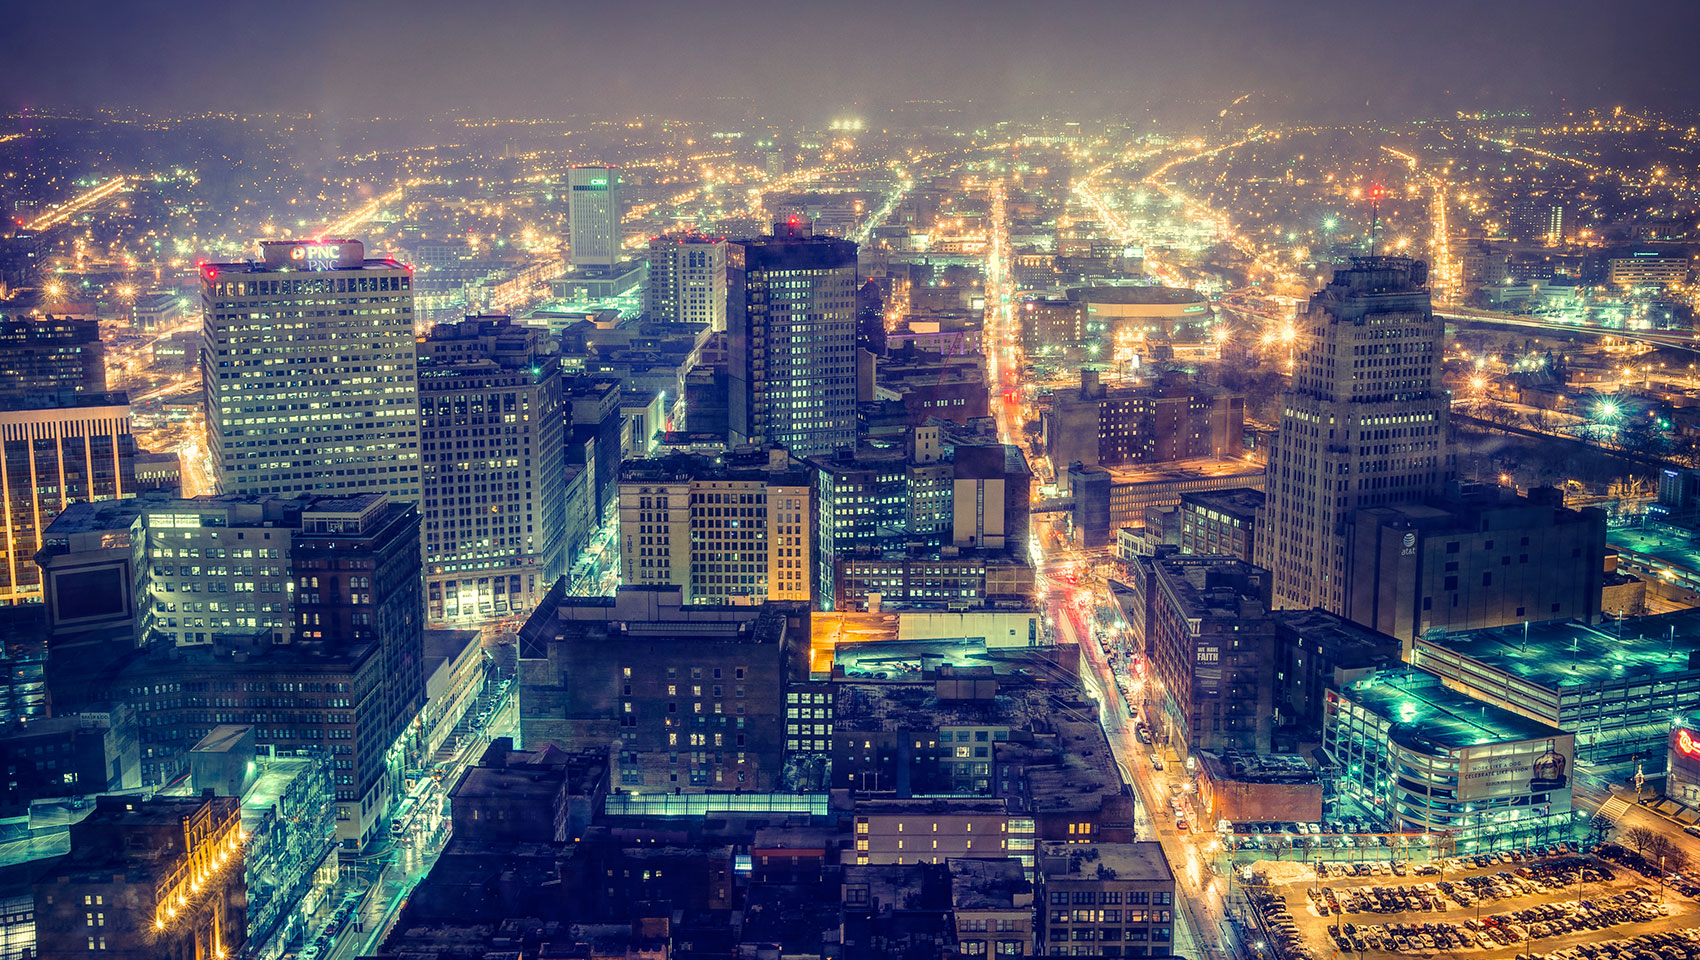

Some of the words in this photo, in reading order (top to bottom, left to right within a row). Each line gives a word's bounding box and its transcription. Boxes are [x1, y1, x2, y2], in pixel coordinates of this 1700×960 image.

[307, 245, 340, 259] PNC
[308, 260, 338, 271] PNC
[1197, 653, 1219, 661] FAITH
